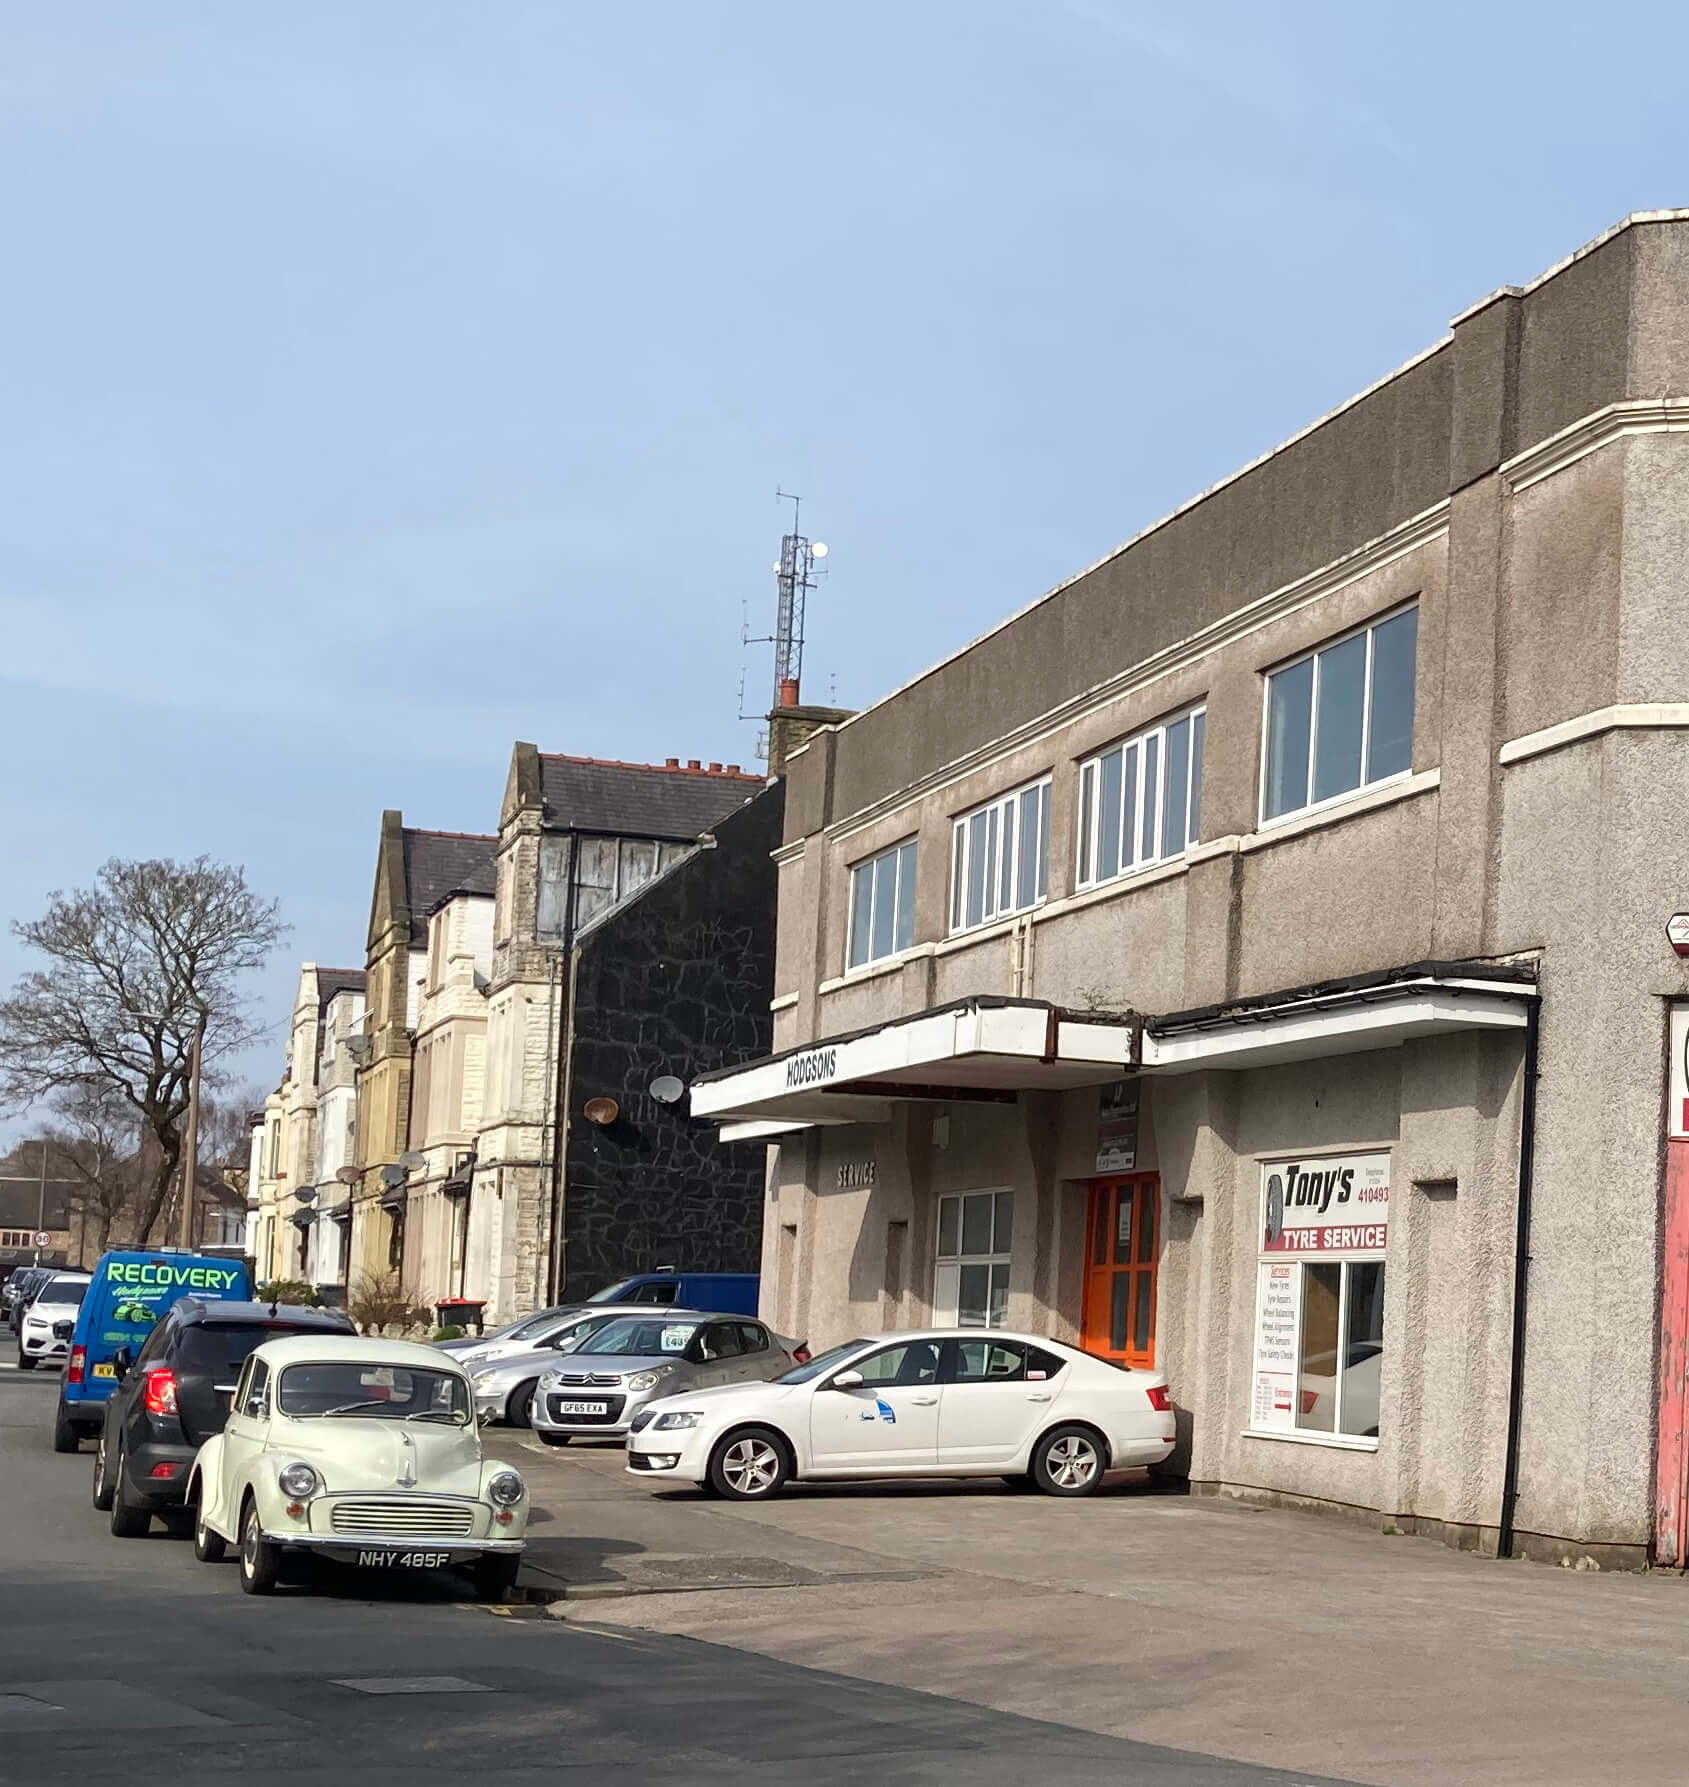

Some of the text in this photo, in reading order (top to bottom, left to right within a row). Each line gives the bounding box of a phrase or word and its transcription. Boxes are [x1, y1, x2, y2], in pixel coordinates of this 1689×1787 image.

[786, 1049, 837, 1088] HODGSONS
[838, 1161, 875, 1187] SERVICE
[1284, 1165, 1355, 1214] Tony's
[1358, 1187, 1389, 1203] 410493
[1283, 1227, 1385, 1249] TYRE SERVICE
[107, 1262, 238, 1290] RECOVERY
[564, 1403, 603, 1413] GF65 EXA
[358, 1551, 450, 1568] NHY 485F
